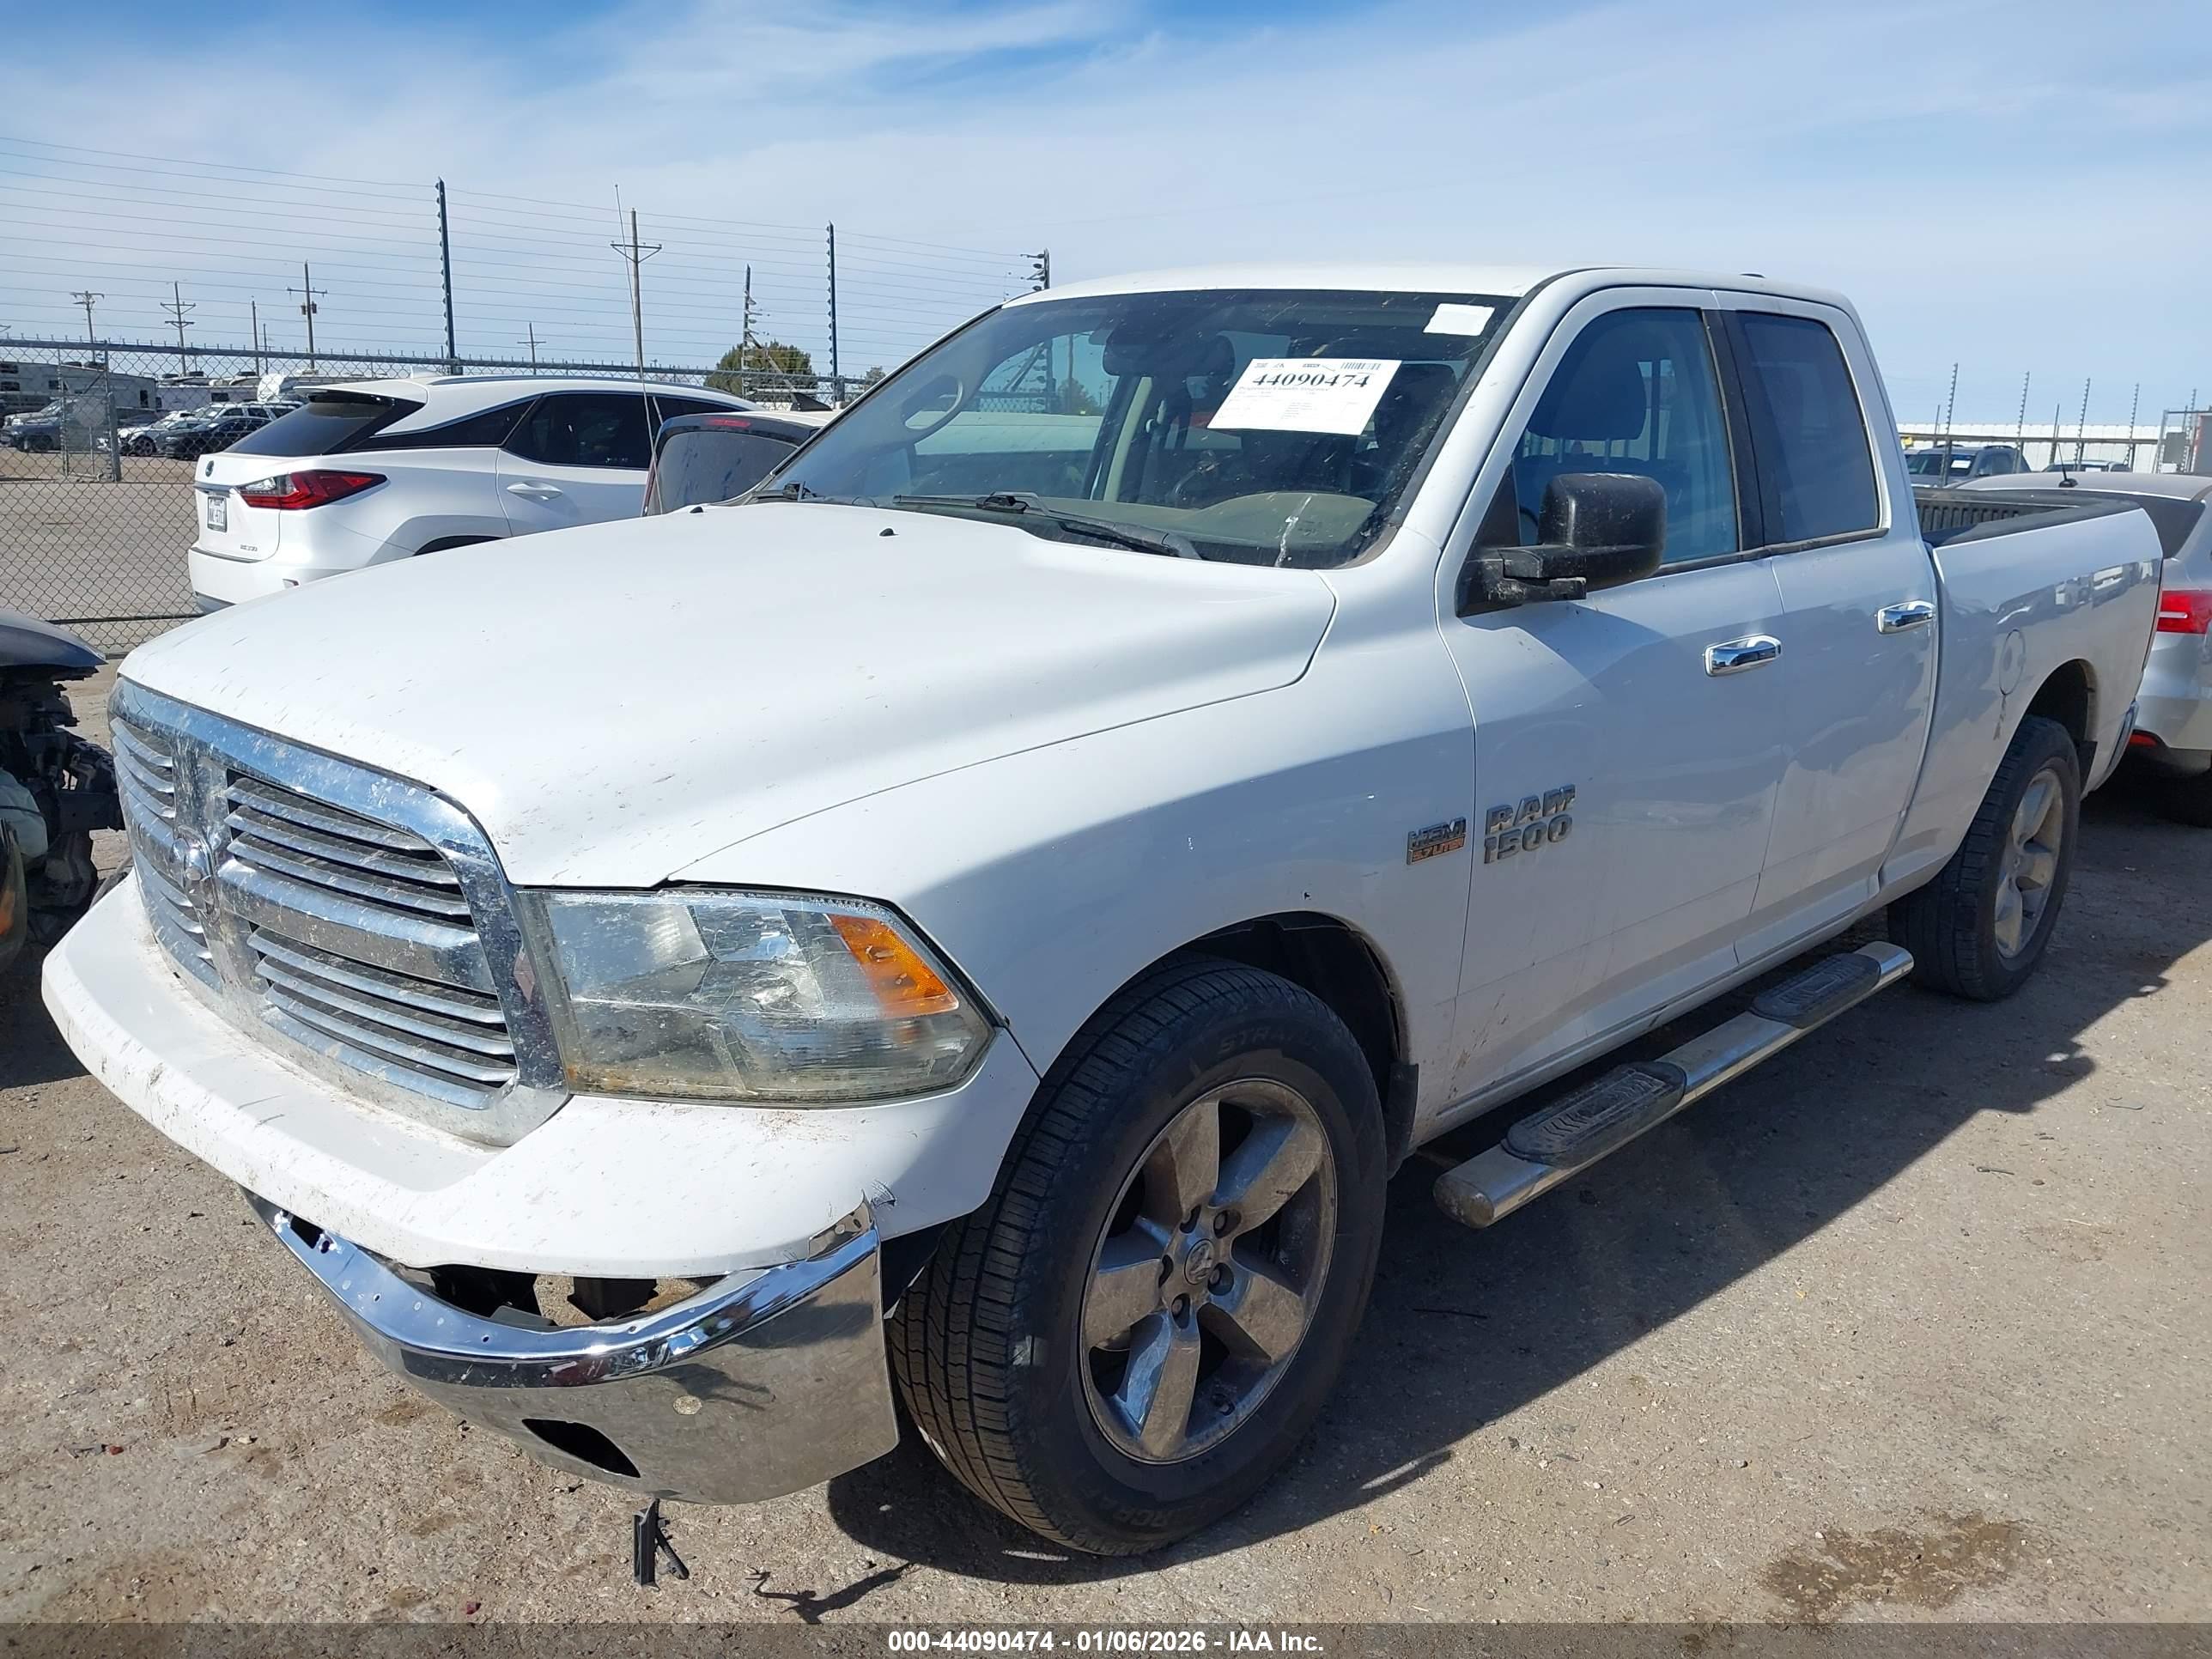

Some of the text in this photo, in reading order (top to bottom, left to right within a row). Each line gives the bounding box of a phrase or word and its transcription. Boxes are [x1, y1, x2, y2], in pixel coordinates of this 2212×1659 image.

[1253, 374, 1370, 387] 44090474
[1485, 784, 1576, 836] RAM
[1484, 813, 1573, 864] 1500
